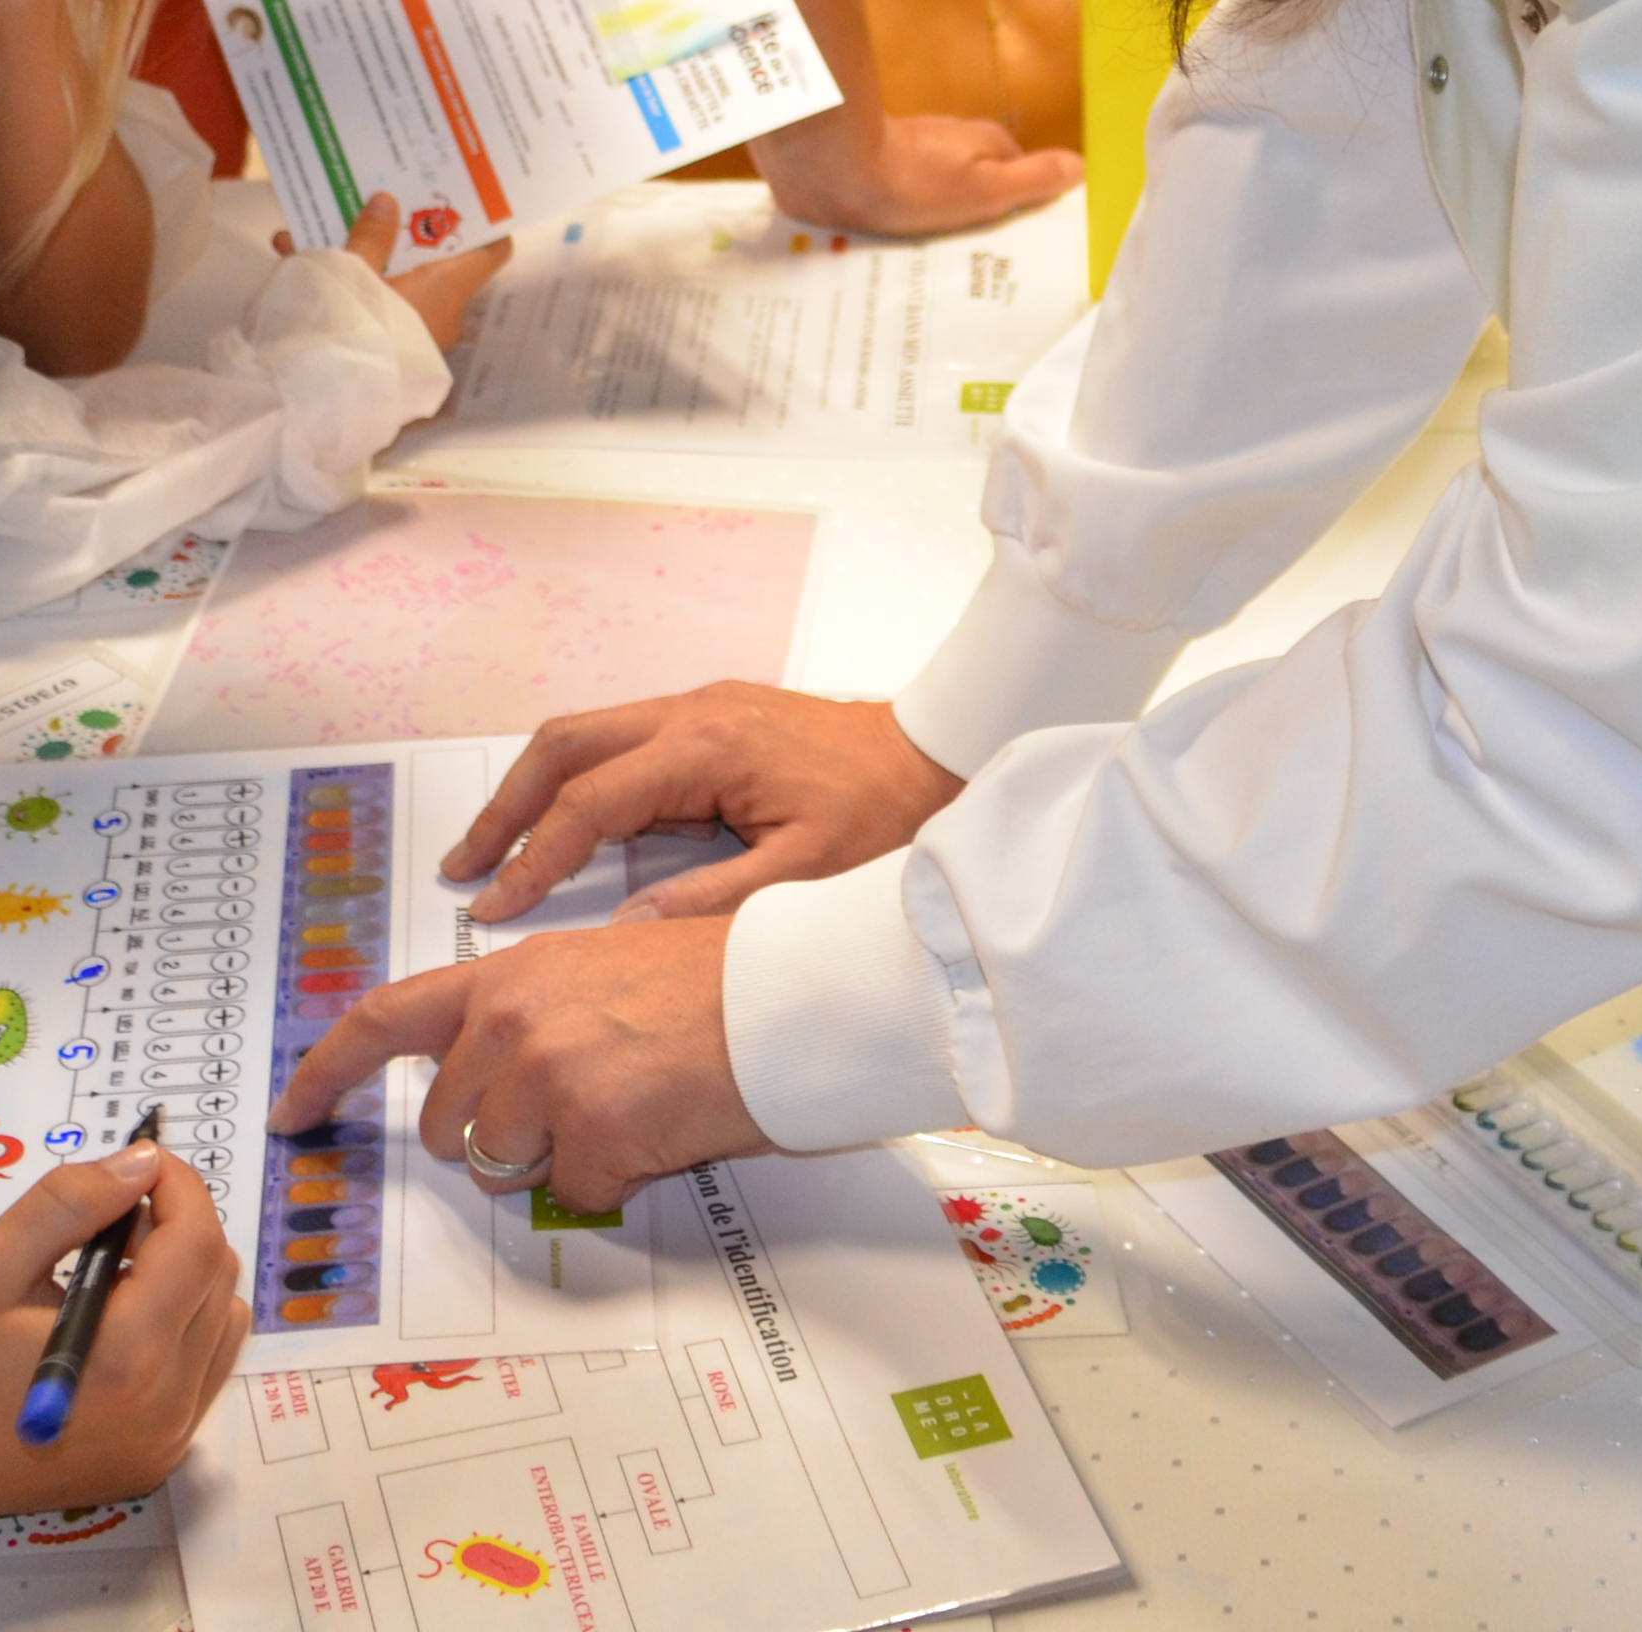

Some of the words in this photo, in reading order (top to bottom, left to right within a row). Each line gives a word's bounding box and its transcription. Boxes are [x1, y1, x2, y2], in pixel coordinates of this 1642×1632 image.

[87, 888, 117, 903] 0
[59, 1045, 93, 1059] 5
[46, 1130, 83, 1147] 5
[708, 1202, 734, 1226] de
[706, 1370, 738, 1412] ROSE
[270, 1405, 286, 1423] NE
[935, 1395, 968, 1438] DRO
[638, 1472, 672, 1530] OVALE
[944, 1462, 980, 1522] laboratoire
[570, 1513, 607, 1584] FAMILLE
[304, 1556, 324, 1580] API
[327, 1544, 358, 1613] GALERIE
[309, 1582, 328, 1600] 20
[314, 1601, 332, 1614] E
